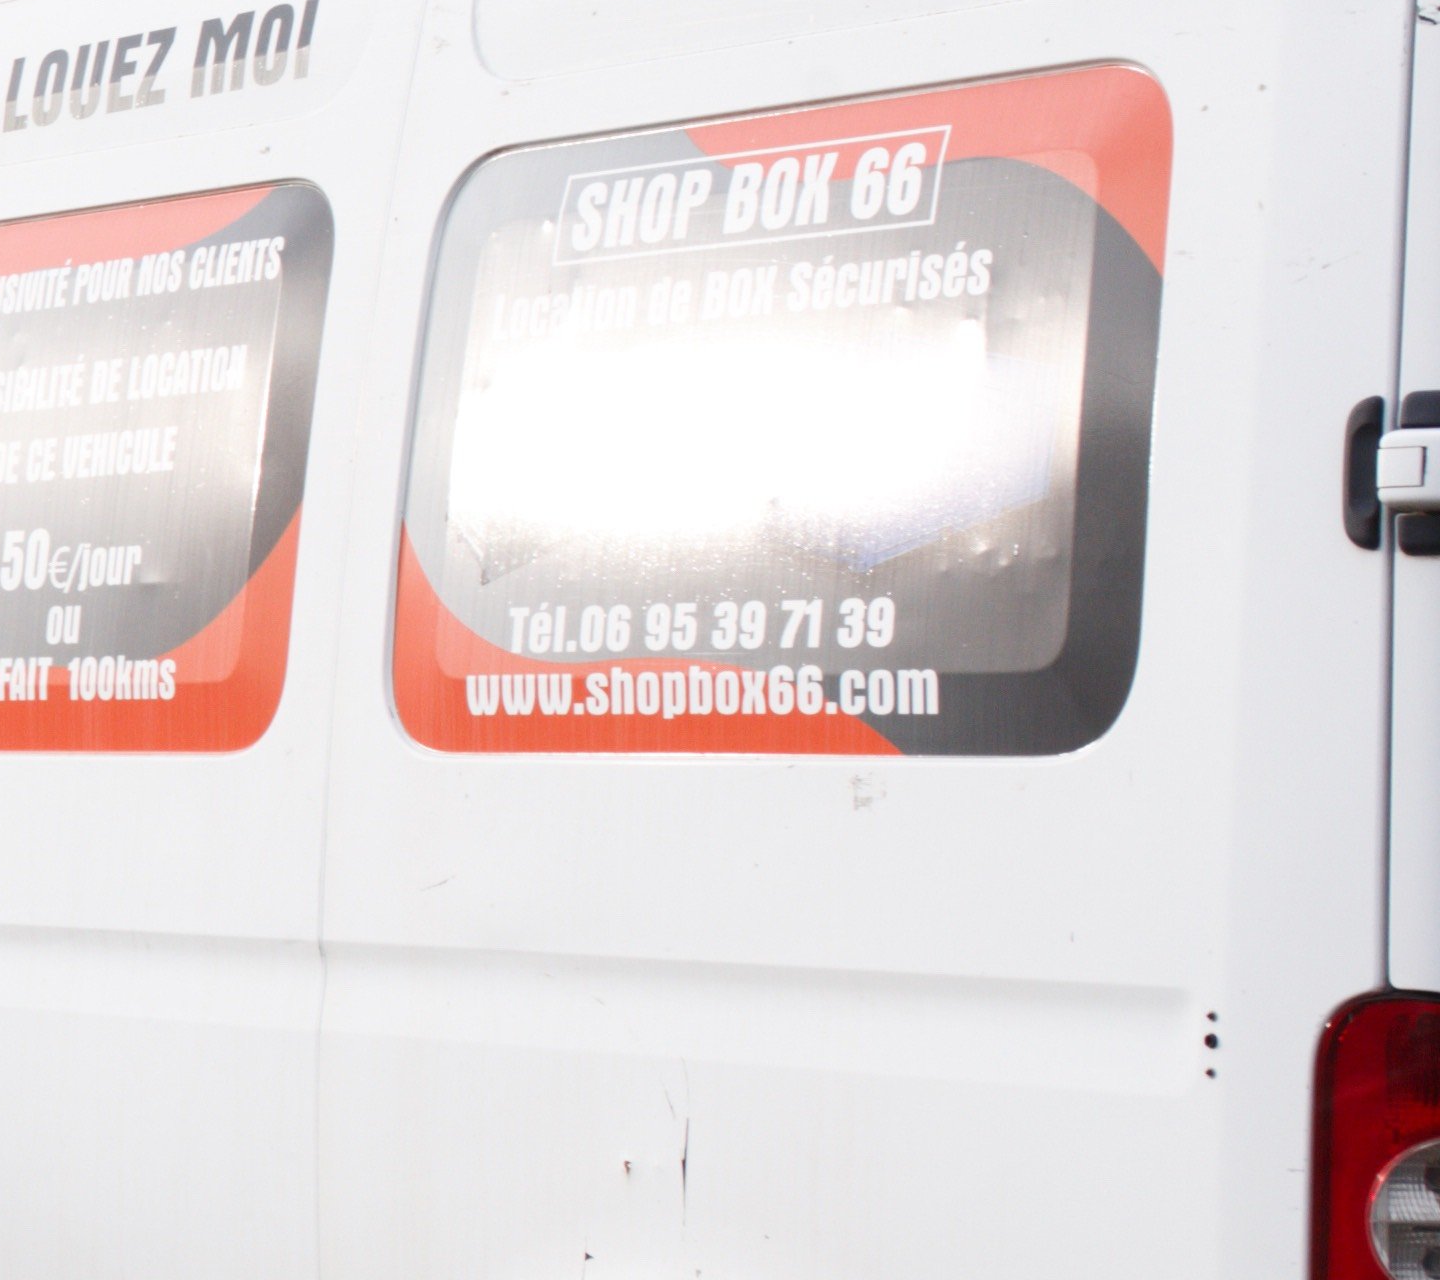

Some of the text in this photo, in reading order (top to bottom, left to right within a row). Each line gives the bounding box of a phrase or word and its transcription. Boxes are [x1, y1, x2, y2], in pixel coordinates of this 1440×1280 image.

[2, 25, 178, 135] LOUEZ
[571, 140, 927, 254] SHOP BOX 66
[72, 257, 135, 307] POUR
[136, 249, 187, 297] NOS
[188, 236, 286, 290] CLIENTS
[491, 240, 995, 342] Location de BOX Sécurisés
[89, 357, 125, 405] DE
[126, 344, 248, 401] LOCATION
[25, 437, 59, 483] CE
[61, 425, 179, 480] VEHICULE
[44, 603, 82, 647] ou
[509, 596, 897, 657] Tél.06 95 39 71 39
[67, 653, 177, 703] 100kms
[465, 662, 940, 721] www.shopbox66.com
